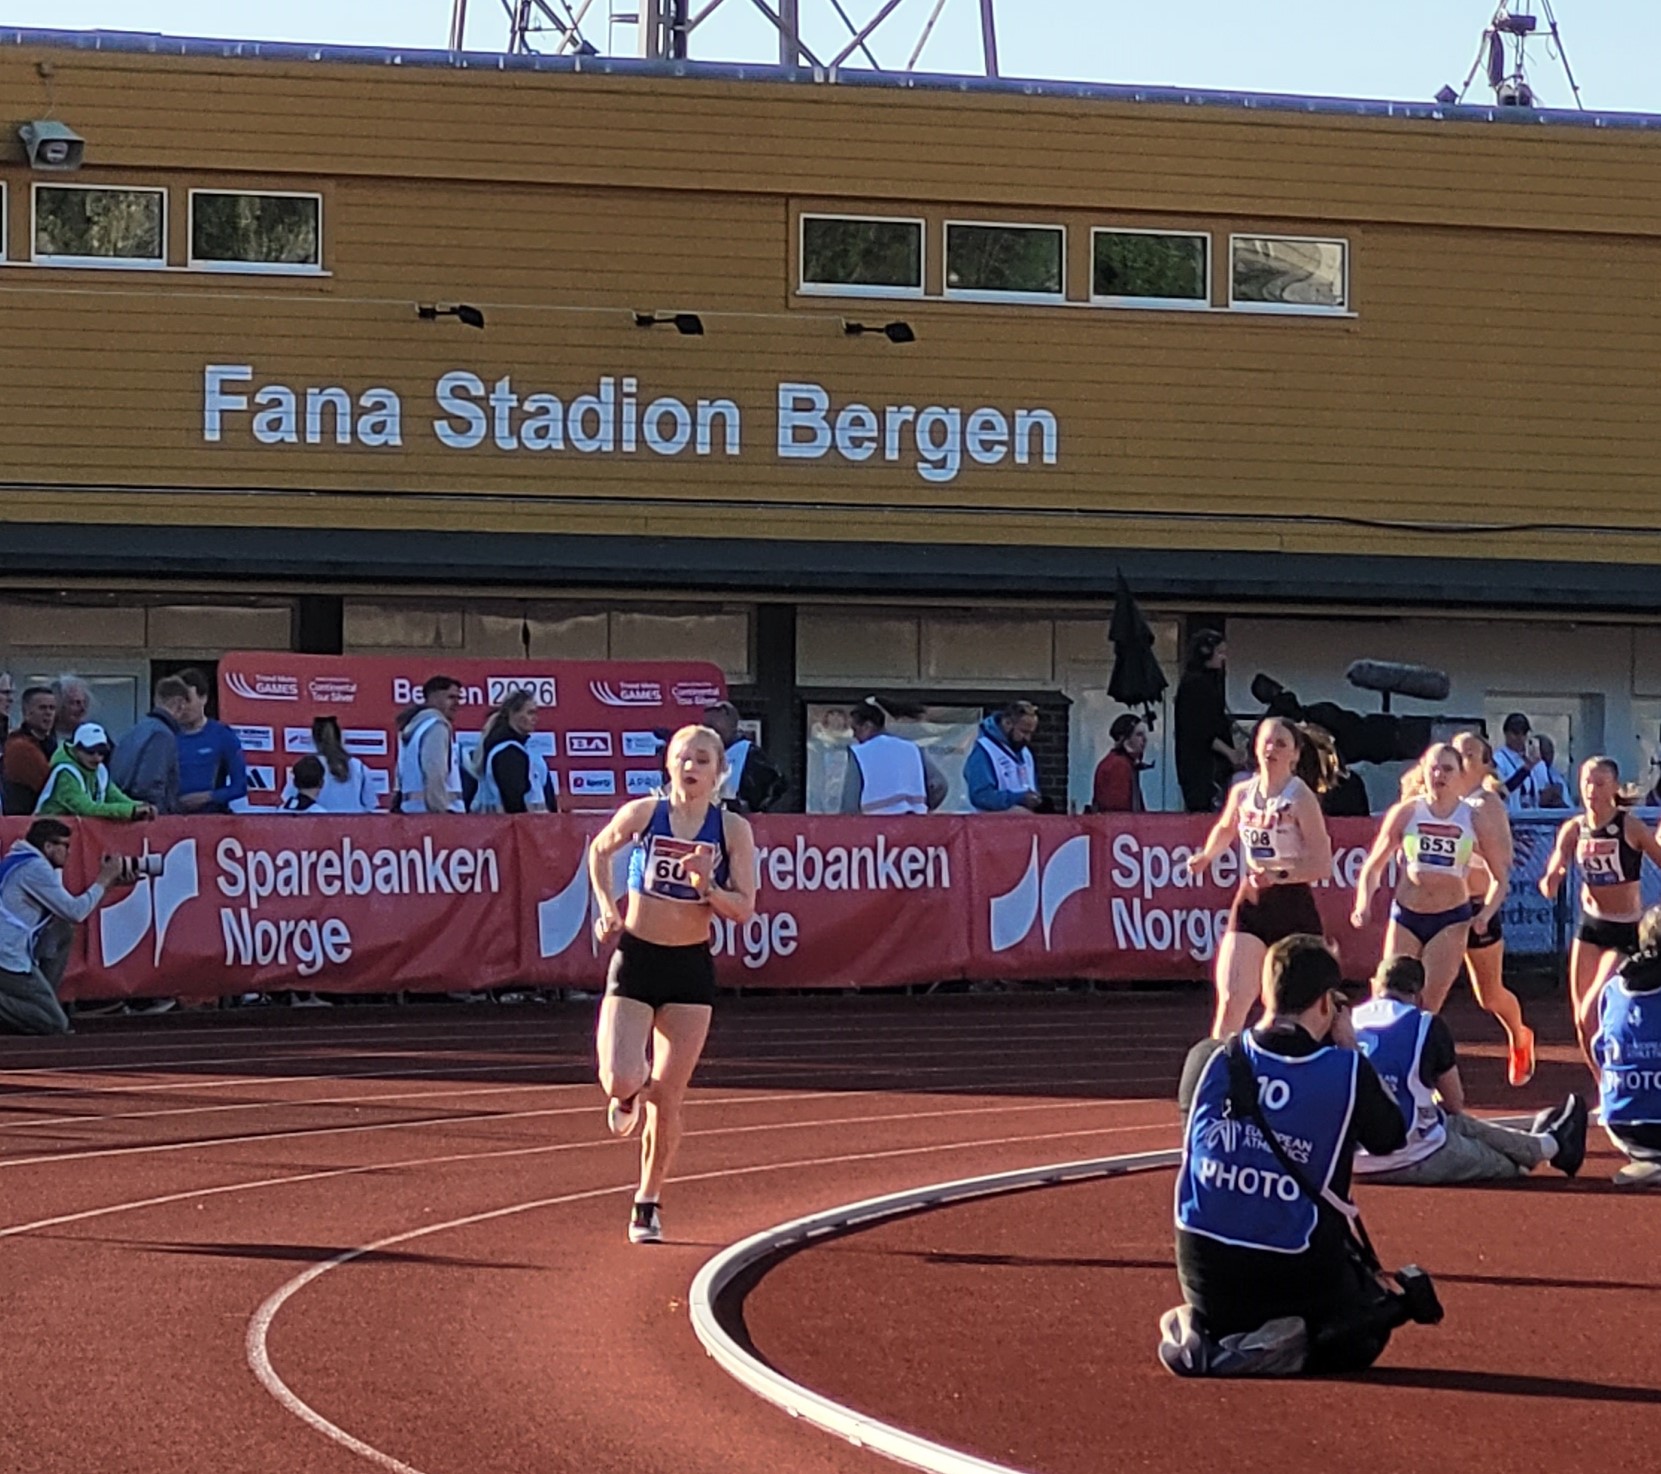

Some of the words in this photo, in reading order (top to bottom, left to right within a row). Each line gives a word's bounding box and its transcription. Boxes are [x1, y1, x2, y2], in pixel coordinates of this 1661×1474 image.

[204, 365, 402, 447] Fana
[433, 371, 740, 456] Stadion
[778, 383, 1057, 482] Bergen
[256, 682, 299, 694] GAMES
[394, 679, 484, 705] Been
[753, 834, 950, 891] rebanken
[1420, 836, 1456, 854] 653
[216, 836, 499, 909] Sparebanken
[656, 859, 688, 882] 60
[220, 907, 352, 976] Norge
[709, 911, 798, 968] orge
[1257, 1075, 1290, 1110] 10
[1201, 1156, 1300, 1201] PHOTO
